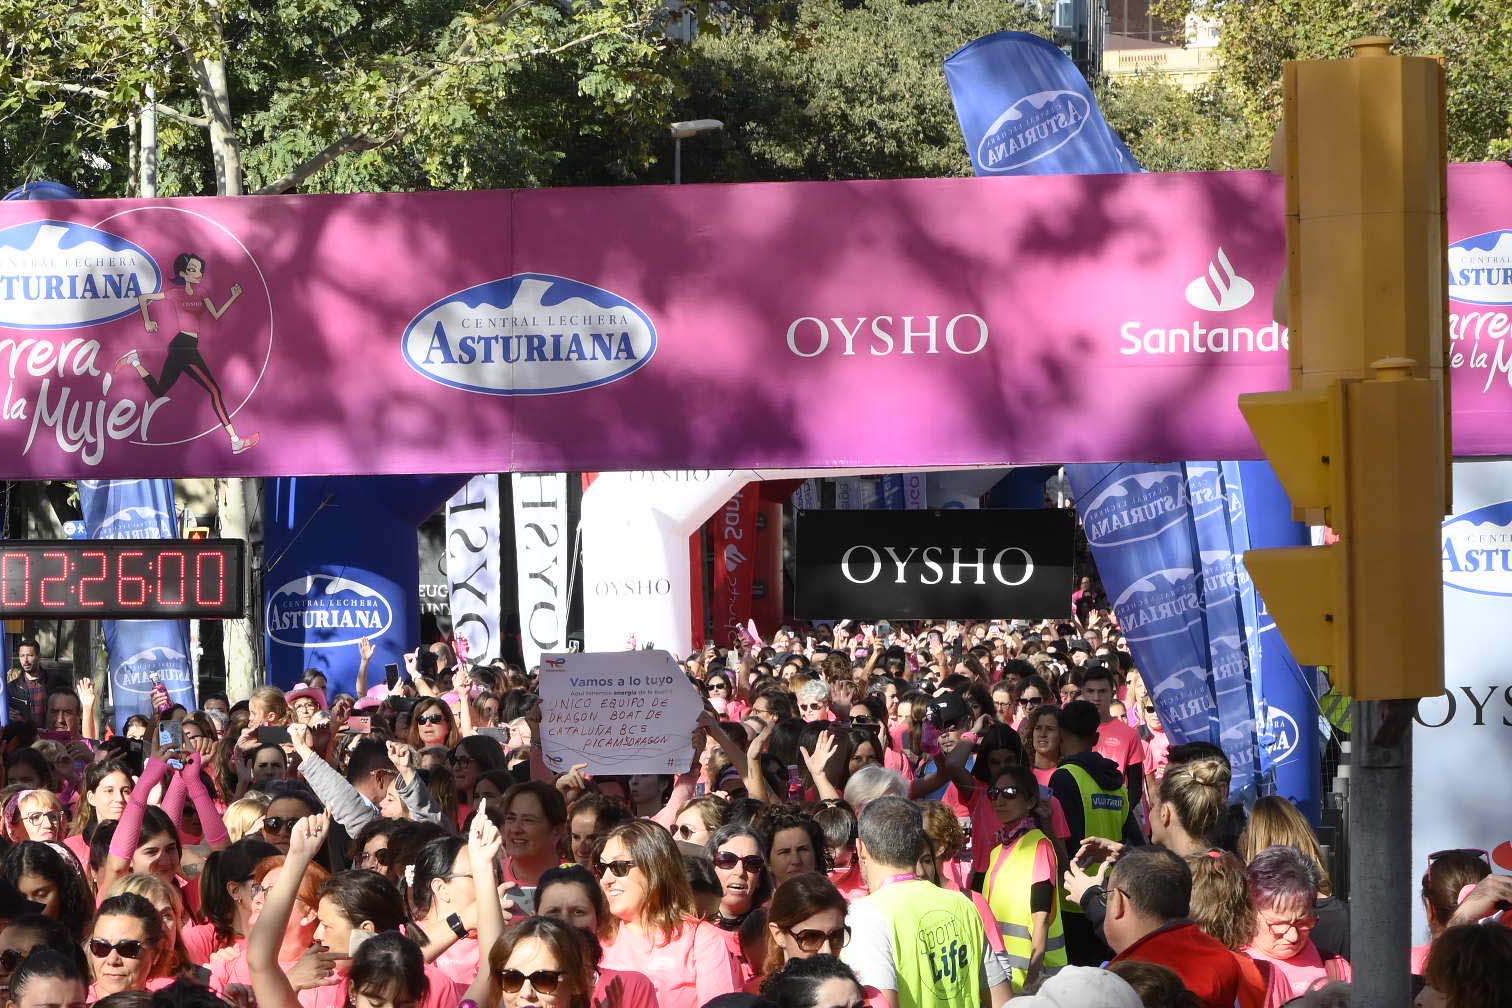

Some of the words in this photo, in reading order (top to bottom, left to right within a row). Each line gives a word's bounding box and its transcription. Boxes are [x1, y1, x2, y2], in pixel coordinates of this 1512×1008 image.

[65, 256, 136, 268] LECHERA
[461, 316, 540, 328] CENTRAL
[548, 314, 628, 326] LECHERA
[786, 313, 988, 357] OYSHO
[422, 320, 637, 364] ASTURIANA
[2, 381, 28, 421] la
[23, 371, 171, 466] Mujer
[1, 552, 225, 607] 02:26:00
[841, 544, 1035, 587] OYSHO
[595, 577, 671, 597] OYSHO
[270, 603, 383, 631] ASTURIANA
[328, 599, 379, 608] LECHERA
[570, 676, 614, 687] Vamos
[617, 678, 625, 686] a
[629, 676, 641, 686] lo
[646, 675, 673, 688] tuyo
[610, 710, 641, 721] BOAT
[645, 710, 663, 720] DE
[651, 698, 670, 708] DE
[919, 919, 957, 955] Sport
[929, 940, 969, 985] Life
